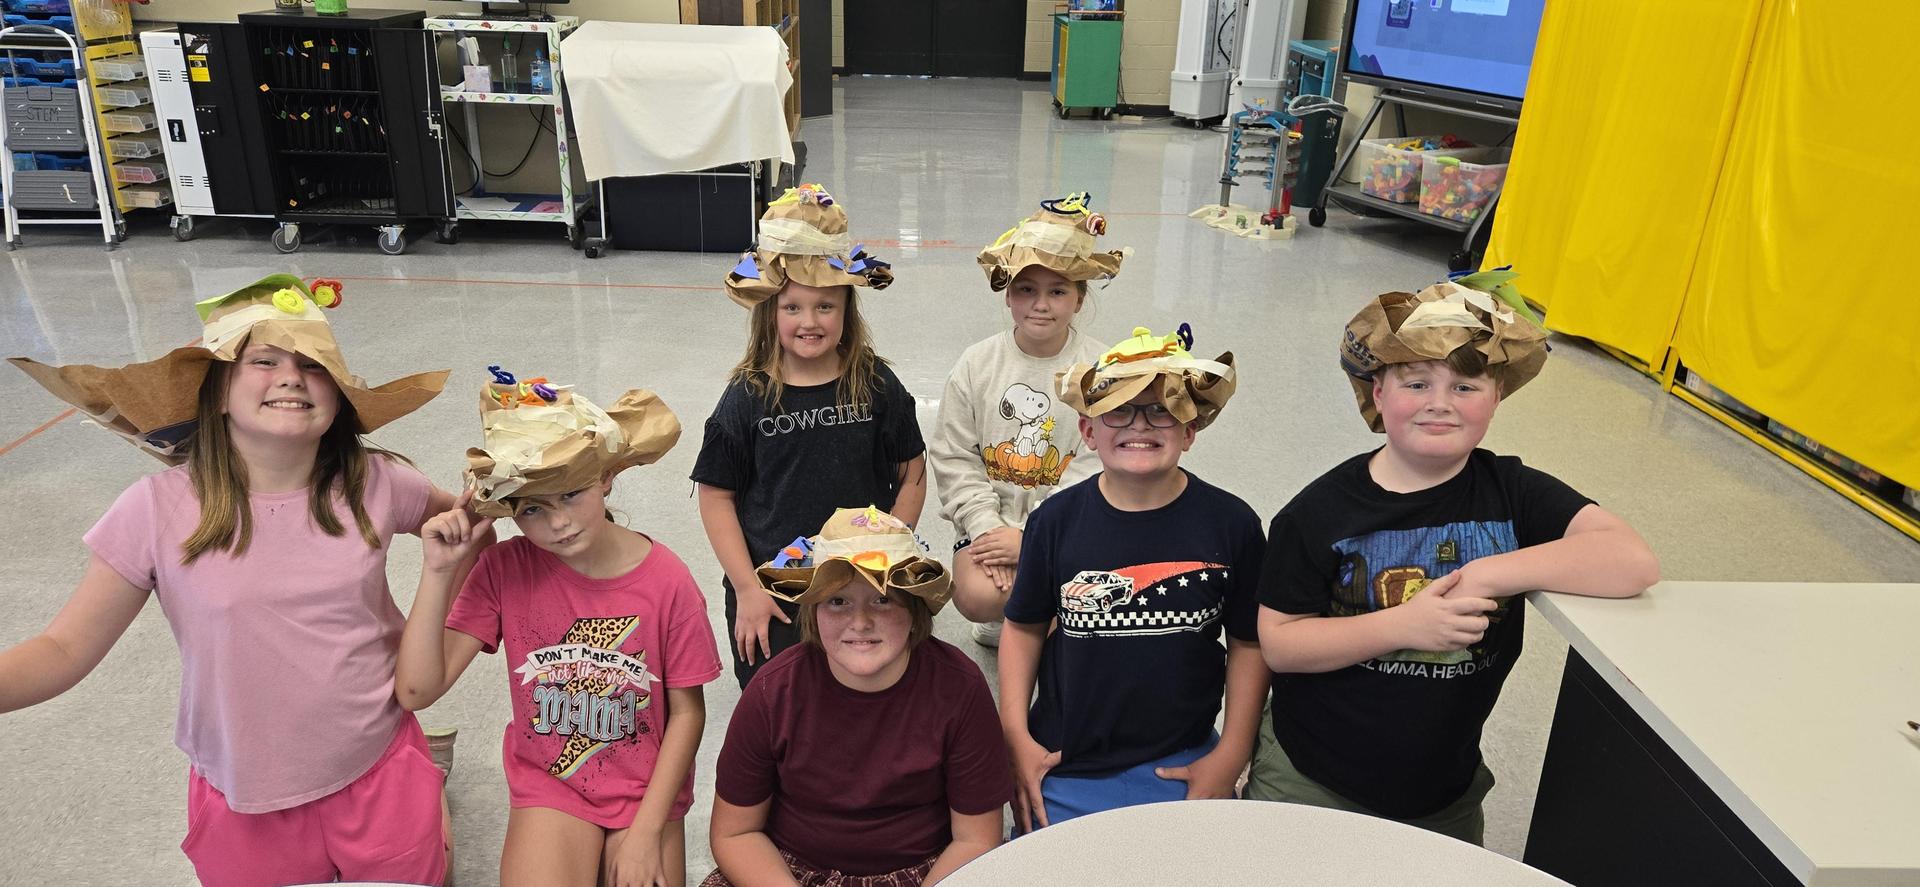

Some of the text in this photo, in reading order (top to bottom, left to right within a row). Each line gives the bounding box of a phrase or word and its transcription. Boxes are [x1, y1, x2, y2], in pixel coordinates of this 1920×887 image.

[26, 106, 60, 121] STEM
[758, 403, 872, 437] COWGIRL
[534, 647, 577, 665] DON'T
[621, 659, 643, 677] ME
[576, 659, 602, 679] like
[1378, 661, 1429, 679] IMMA
[1432, 662, 1476, 680] HEAD
